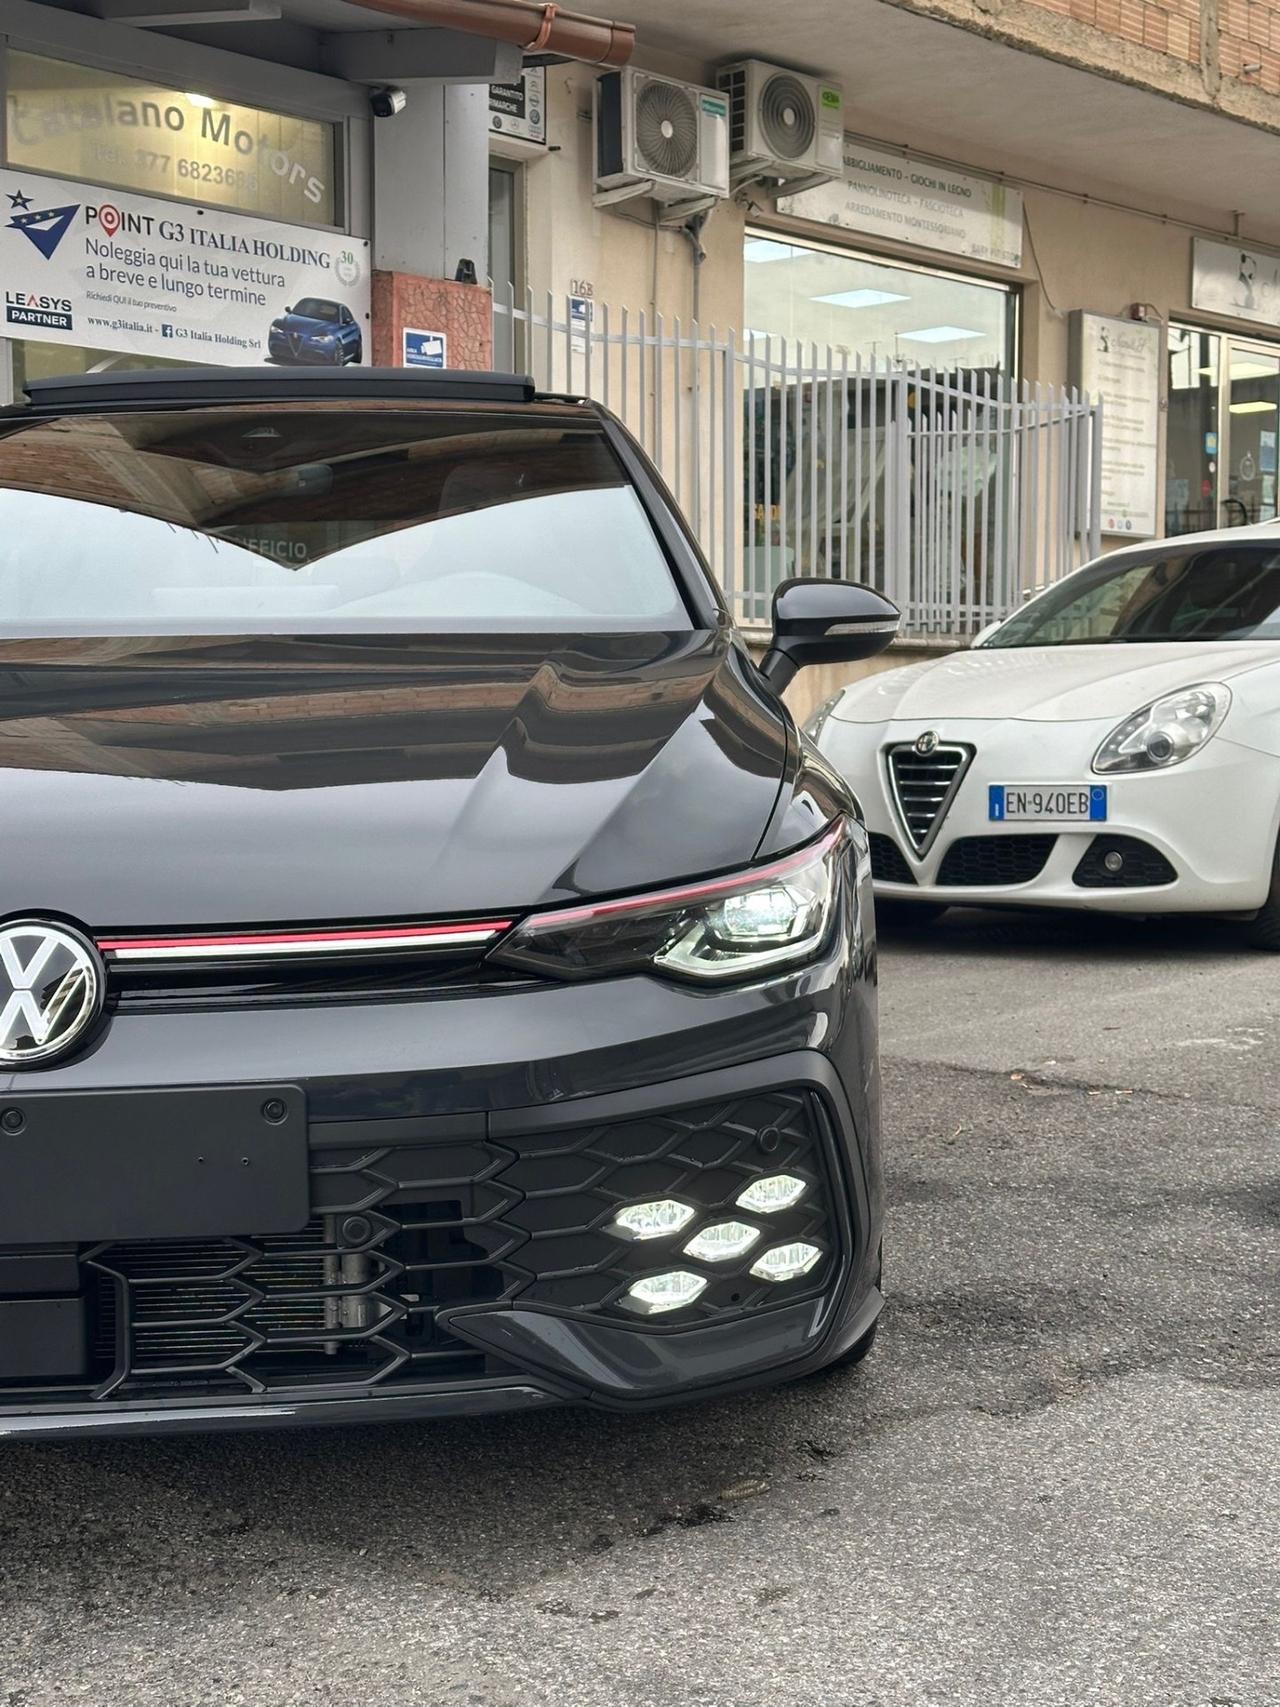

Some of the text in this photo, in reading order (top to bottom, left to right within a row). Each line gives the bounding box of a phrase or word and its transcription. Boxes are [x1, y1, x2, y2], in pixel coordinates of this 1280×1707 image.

[201, 107, 325, 203] Motors
[911, 174, 937, 189] GIOCHI
[938, 181, 946, 192] IN
[948, 184, 972, 198] LEGNO
[85, 204, 330, 269] POINT G3 ITALIA HOLDING
[85, 237, 286, 289] Noleggia qui la tua vettura
[340, 250, 354, 265] 30
[86, 263, 267, 306] a breve e lungo termine
[5, 290, 72, 312] LEASYS
[11, 309, 67, 327] PARTNER
[87, 316, 153, 334] www.g3italia.it
[175, 328, 188, 338] G3
[190, 330, 212, 342] Italia
[214, 333, 247, 348] Holding
[249, 340, 261, 349] Srl
[243, 537, 307, 559] FFICIO
